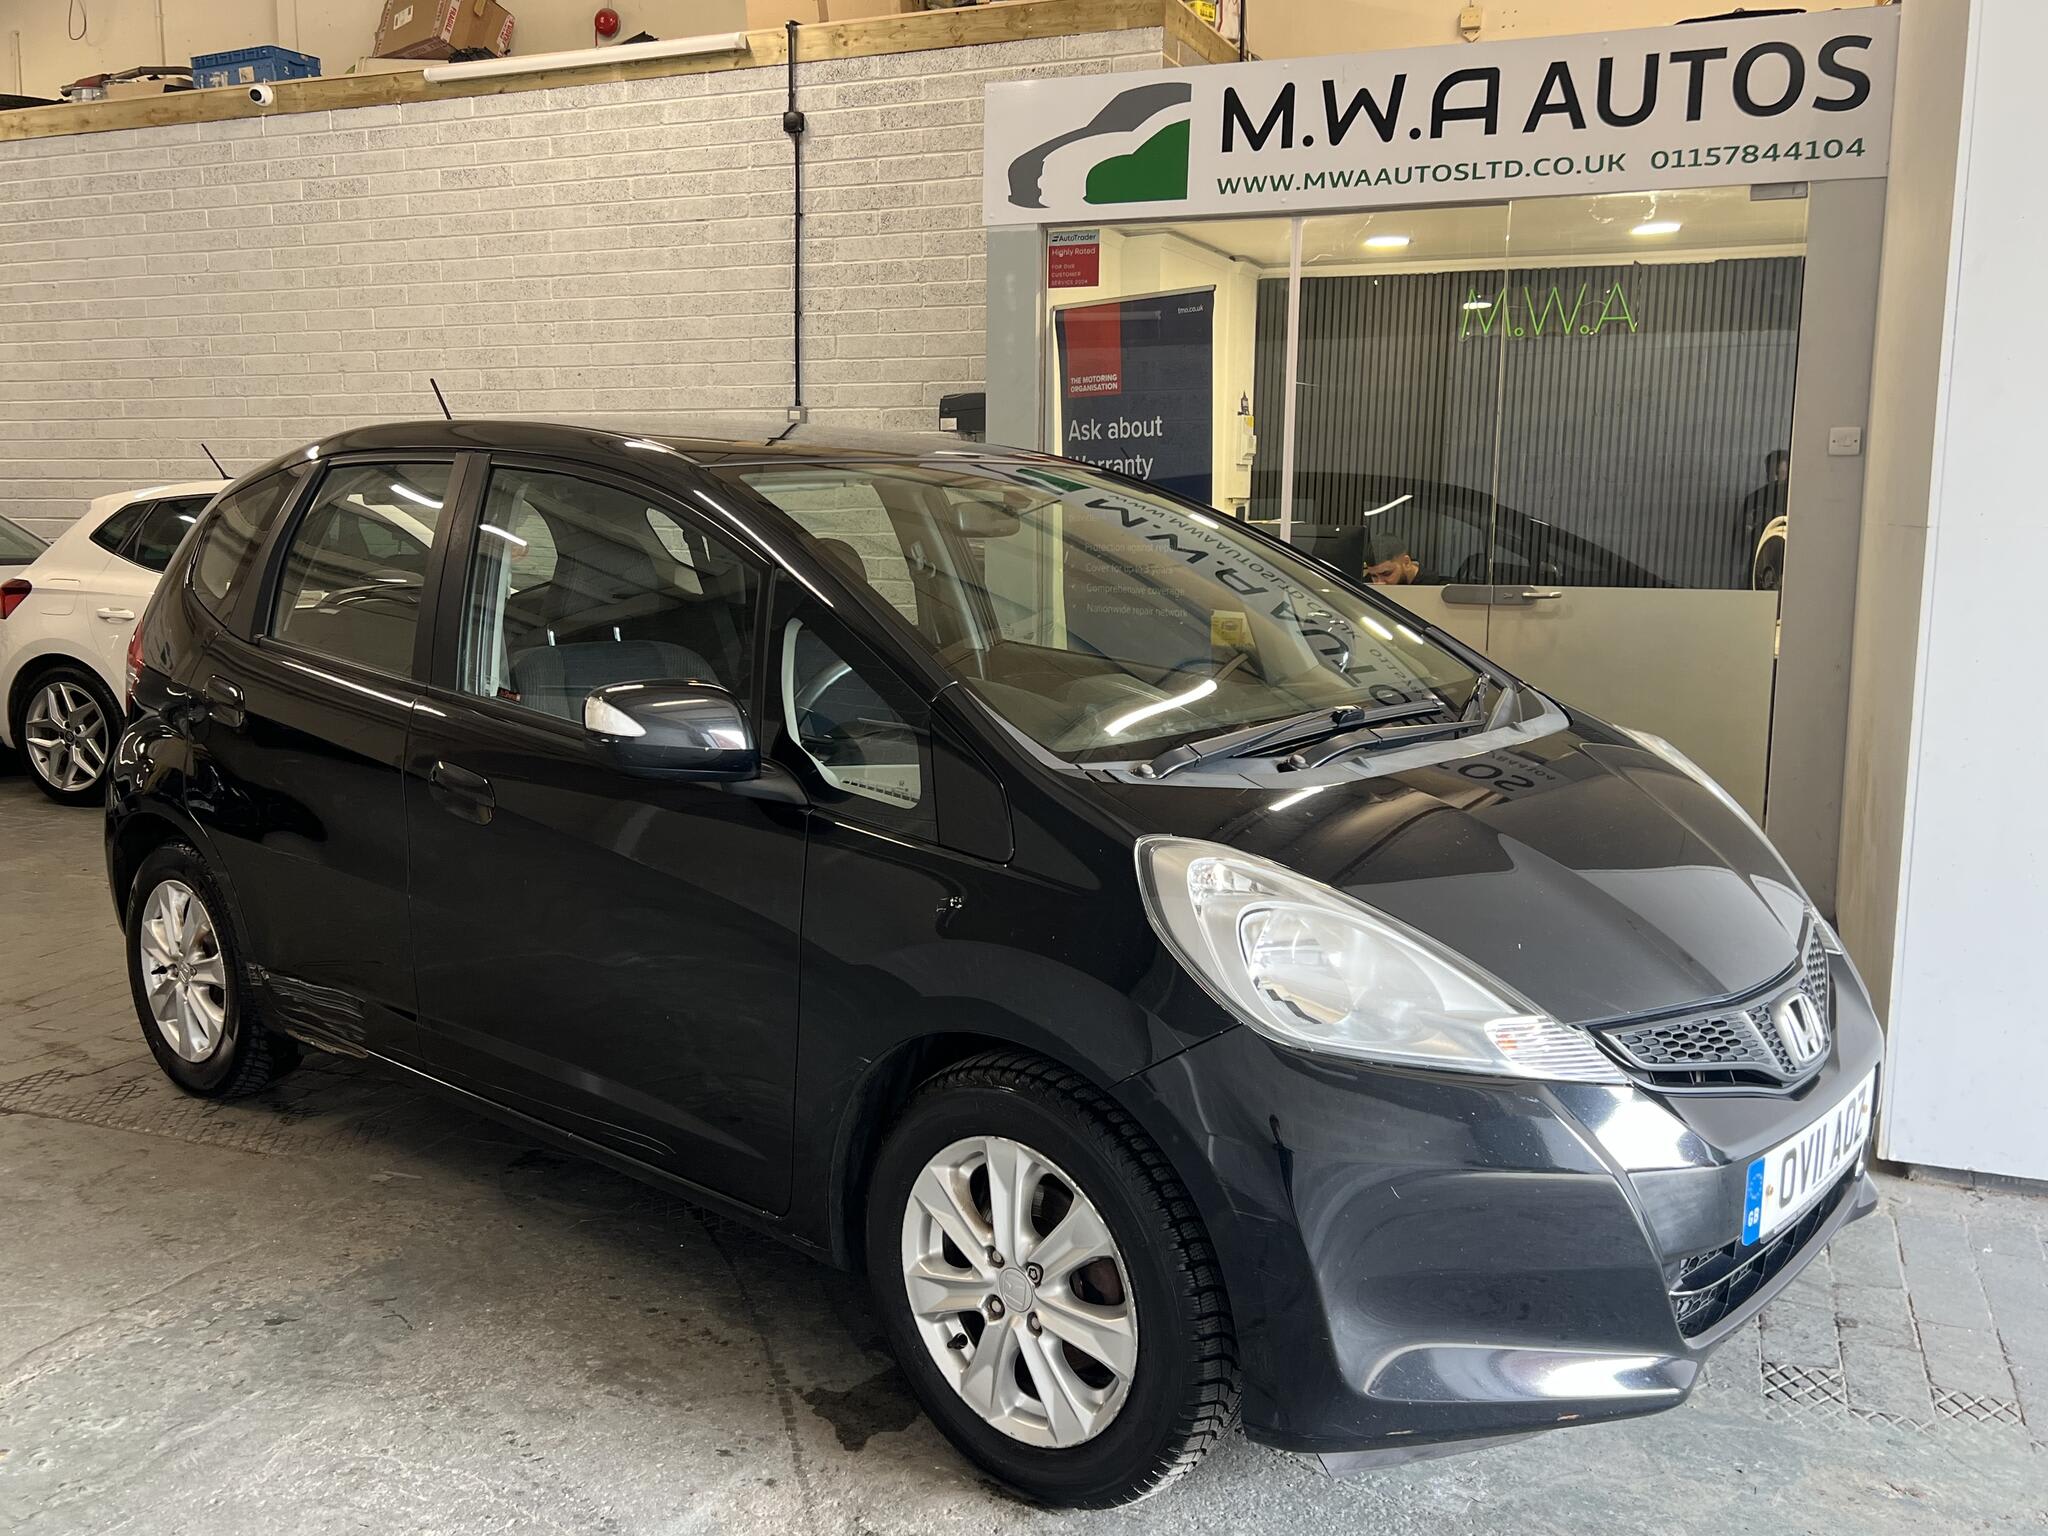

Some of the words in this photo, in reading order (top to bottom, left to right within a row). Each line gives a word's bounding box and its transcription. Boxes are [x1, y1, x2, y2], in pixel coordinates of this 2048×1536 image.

[1221, 66, 1500, 153] M.W.A
[1522, 35, 1873, 134] AUTOS
[1217, 152, 1626, 195] WWW.MWAAUTOSLTD.CO.UK
[1650, 137, 1866, 170] 01157844104
[1058, 233, 1097, 243] AutoTrader
[1461, 281, 1636, 339] M.W.A
[1070, 377, 1082, 385] THE
[1083, 373, 1118, 384] MOTORING
[1070, 382, 1118, 393] ORGANISATION
[1068, 418, 1102, 441] Ask
[1108, 416, 1163, 440] about
[1069, 454, 1154, 481] rranty
[1747, 1207, 1760, 1228] GB
